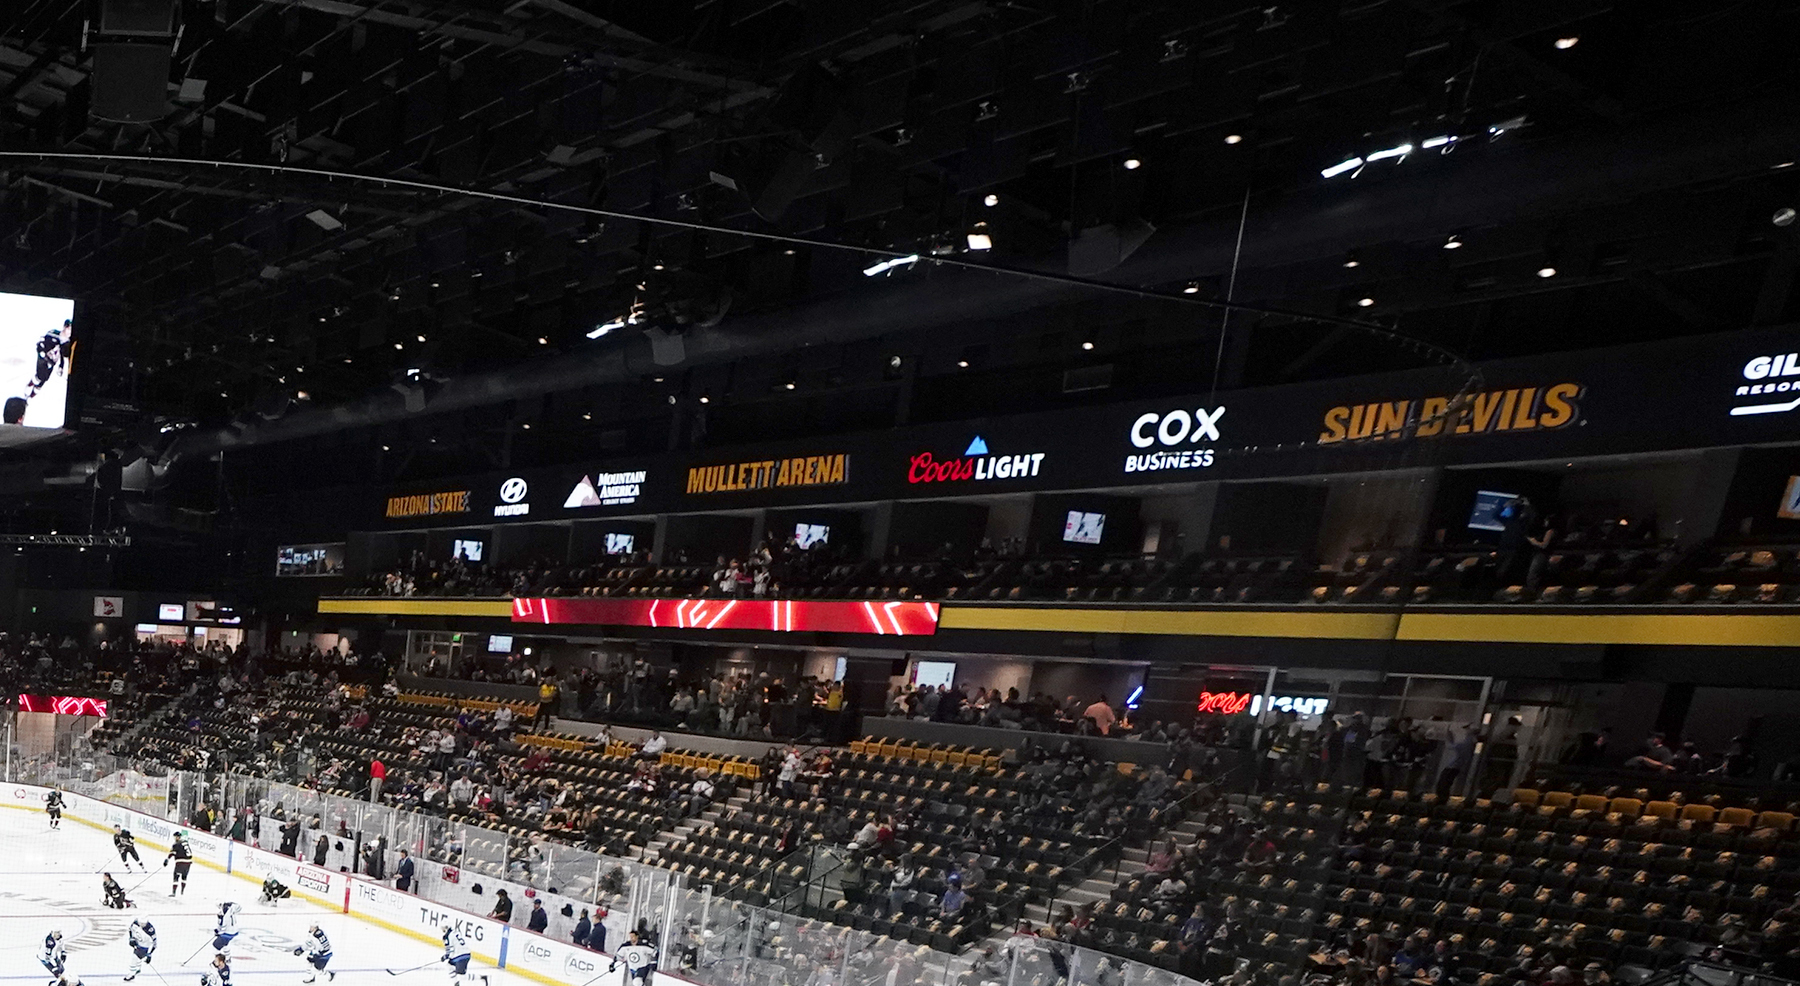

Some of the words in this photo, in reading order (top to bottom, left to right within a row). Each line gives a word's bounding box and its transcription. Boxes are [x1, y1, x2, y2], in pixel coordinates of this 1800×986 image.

[1319, 400, 1406, 445] SUN
[1414, 383, 1580, 439] DEVILS
[1130, 405, 1226, 448] COX
[908, 451, 974, 484] Coors
[974, 452, 1045, 480] LIGHT
[1125, 449, 1214, 473] BUSINESS
[597, 470, 647, 487] MOUNTAIN
[686, 460, 774, 494] MULLETT
[776, 453, 845, 486] ARENA
[599, 484, 640, 499] AMERICA
[385, 494, 430, 517] ARIZONA
[433, 490, 467, 513] STATE
[493, 503, 529, 517] HYUNDAI
[142, 817, 171, 840] MedSupply
[255, 858, 274, 871] Dignity
[272, 863, 291, 877] Health
[298, 867, 329, 883] ARIZONA
[300, 877, 328, 892] SPORTS
[454, 918, 484, 942] KEG
[528, 944, 551, 959] ACP
[569, 957, 595, 972] ACP
